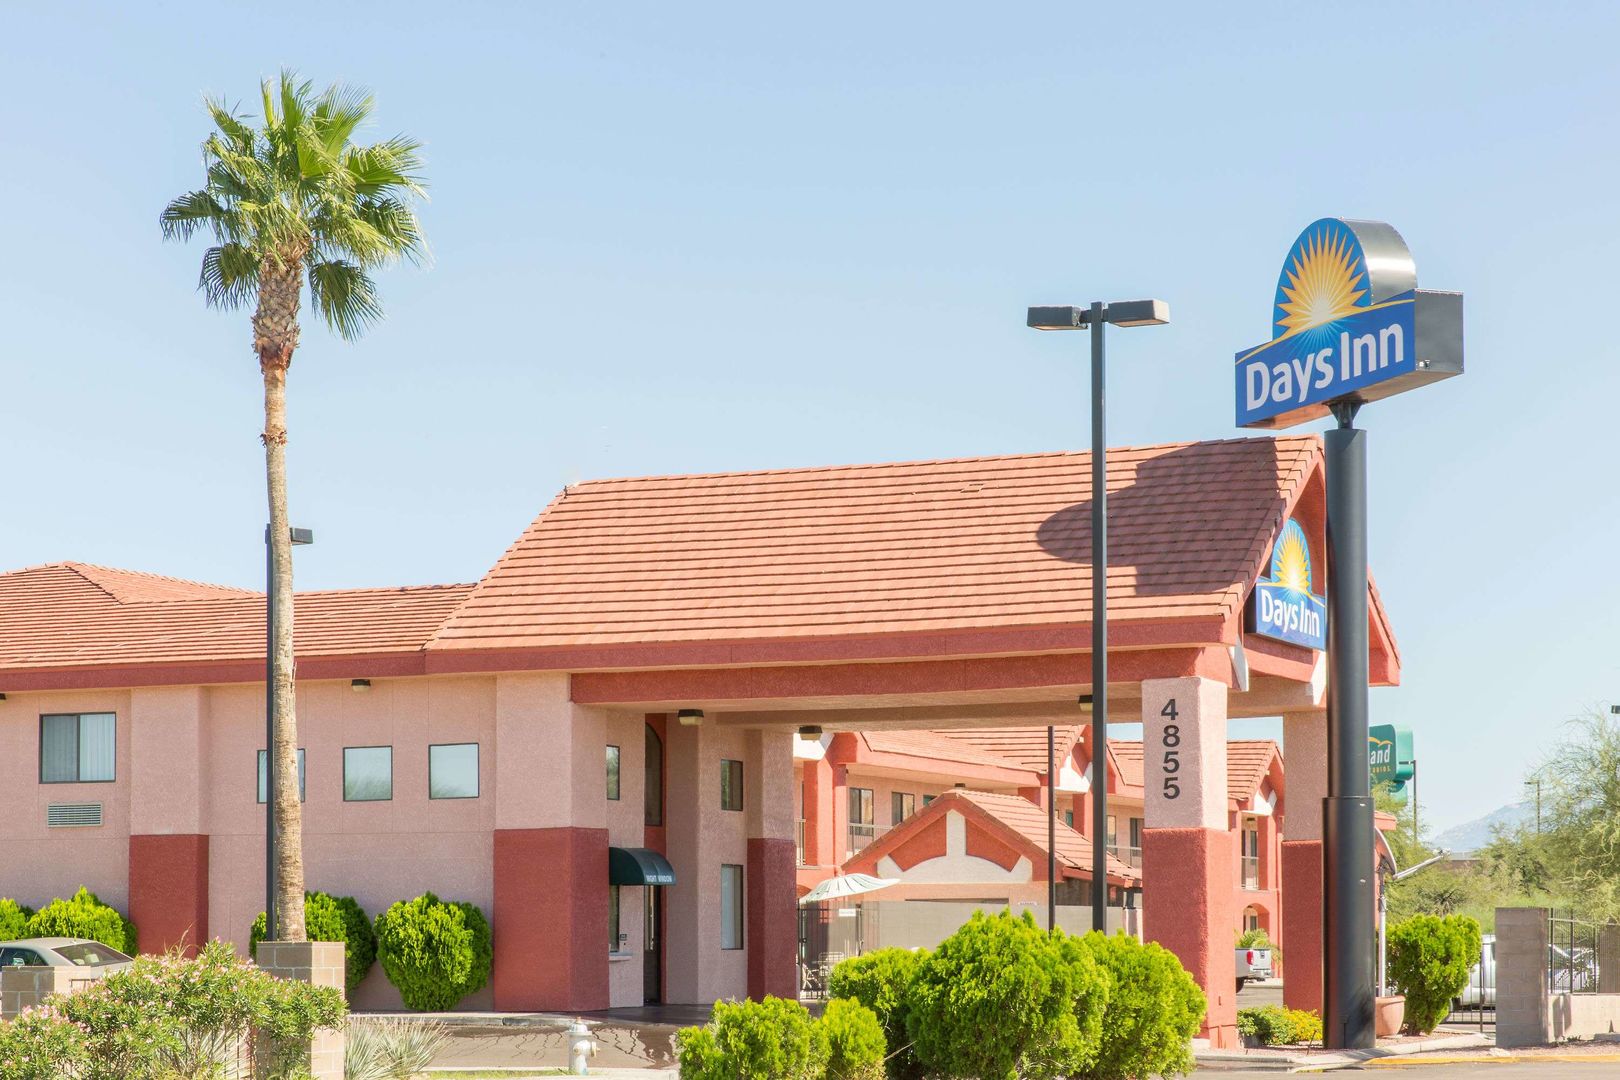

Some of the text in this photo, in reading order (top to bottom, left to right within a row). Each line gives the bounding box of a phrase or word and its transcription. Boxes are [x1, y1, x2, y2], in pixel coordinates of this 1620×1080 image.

[1246, 323, 1404, 411] Days Inn
[1261, 588, 1320, 637] Days Inn
[1161, 698, 1181, 800] 4855
[1370, 744, 1391, 765] and
